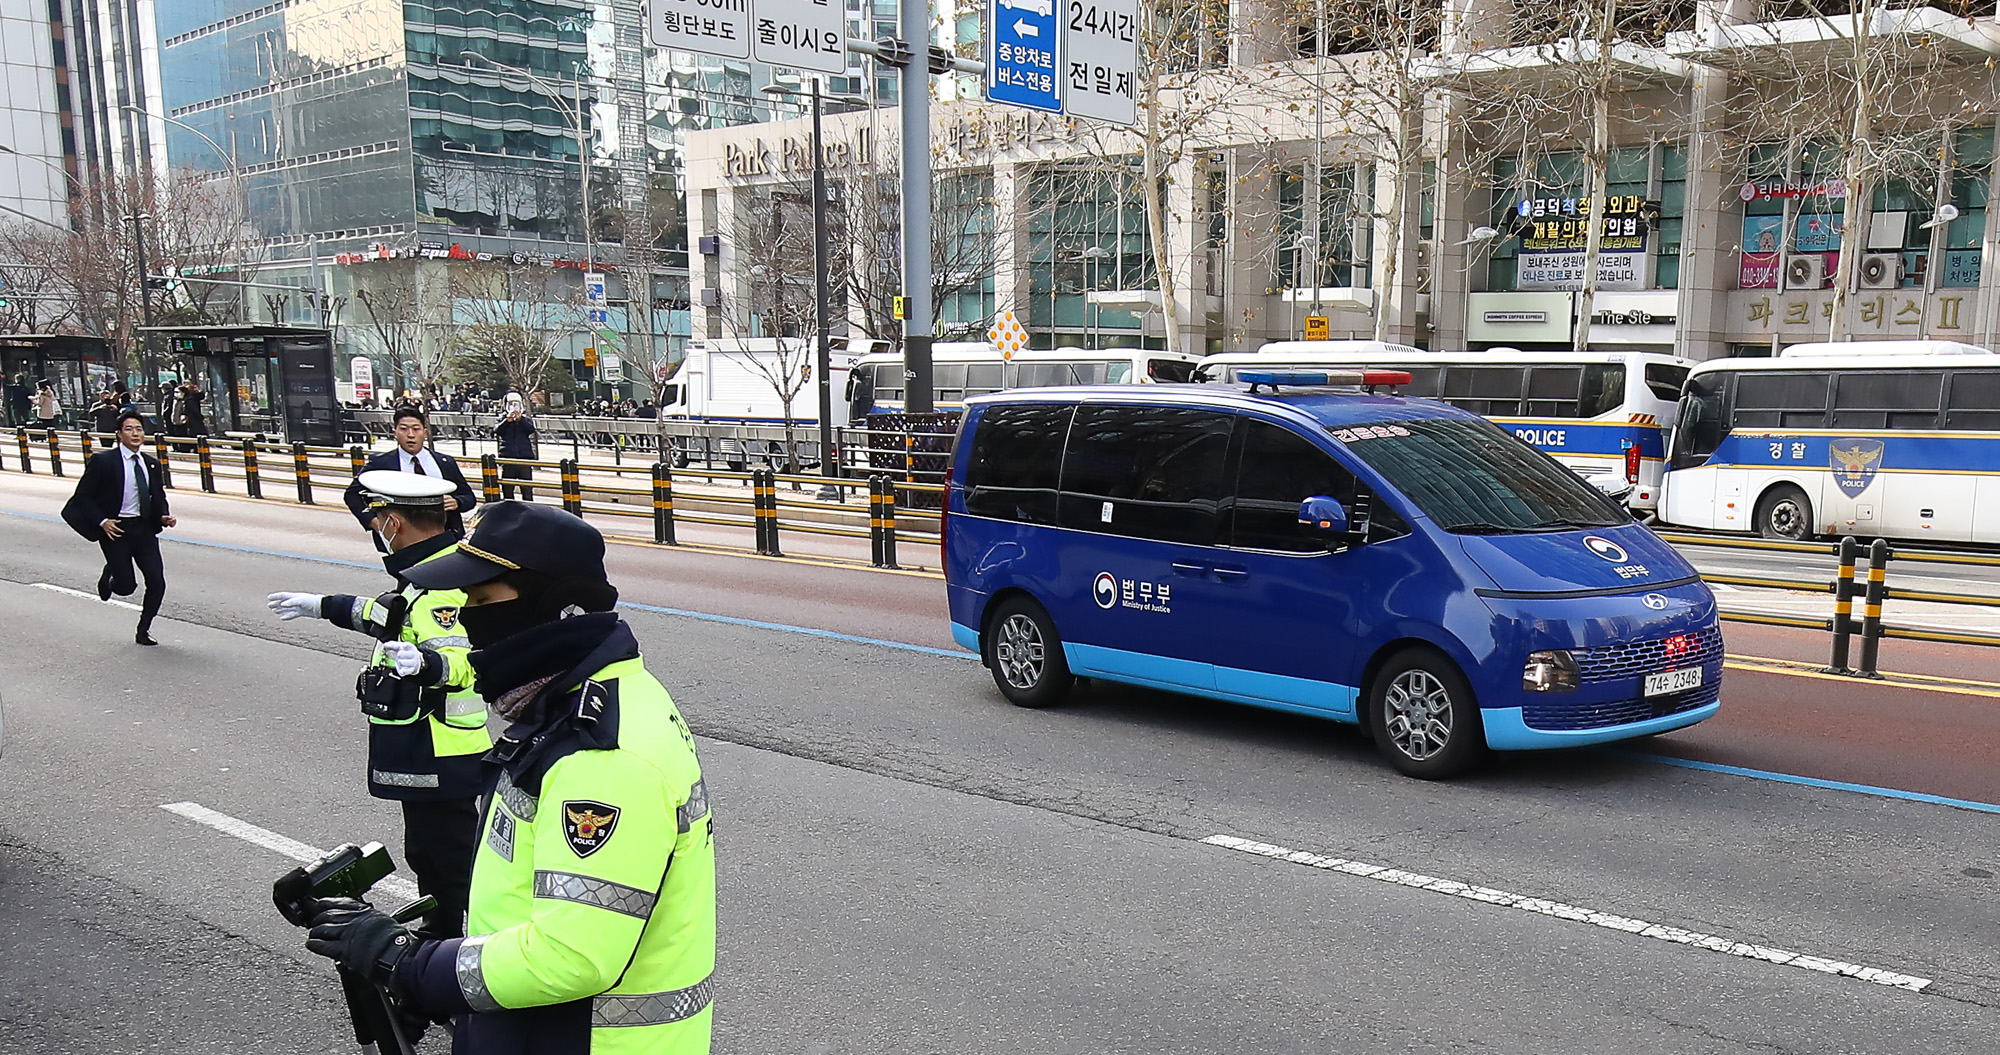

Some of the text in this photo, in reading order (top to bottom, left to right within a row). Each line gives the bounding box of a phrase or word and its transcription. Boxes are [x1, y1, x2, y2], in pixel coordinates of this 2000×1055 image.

[664, 10, 737, 41] 횡단보도
[1070, 1, 1135, 42] 24시간
[757, 18, 841, 54] 줄이시오
[998, 42, 1053, 69] 중앙차로
[998, 66, 1053, 93] 버스전용
[722, 137, 769, 177] Park
[779, 132, 849, 174] Palce
[1527, 257, 1559, 268] 보내주신
[1597, 256, 1631, 268] 사드리며
[1523, 270, 1545, 281] 더나은
[1547, 270, 1571, 281] 진료로
[1598, 309, 1624, 325] The
[1514, 429, 1566, 446] POLICE
[1841, 480, 1865, 488] POLICE
[1613, 564, 1650, 580] 법무부
[1122, 579, 1171, 605] 법무부
[1122, 600, 1143, 611] Ministry
[1151, 604, 1171, 614] Justice
[1650, 670, 1698, 696] 74수 2348
[489, 831, 510, 855] POLICE
[573, 838, 597, 846] POLICE
